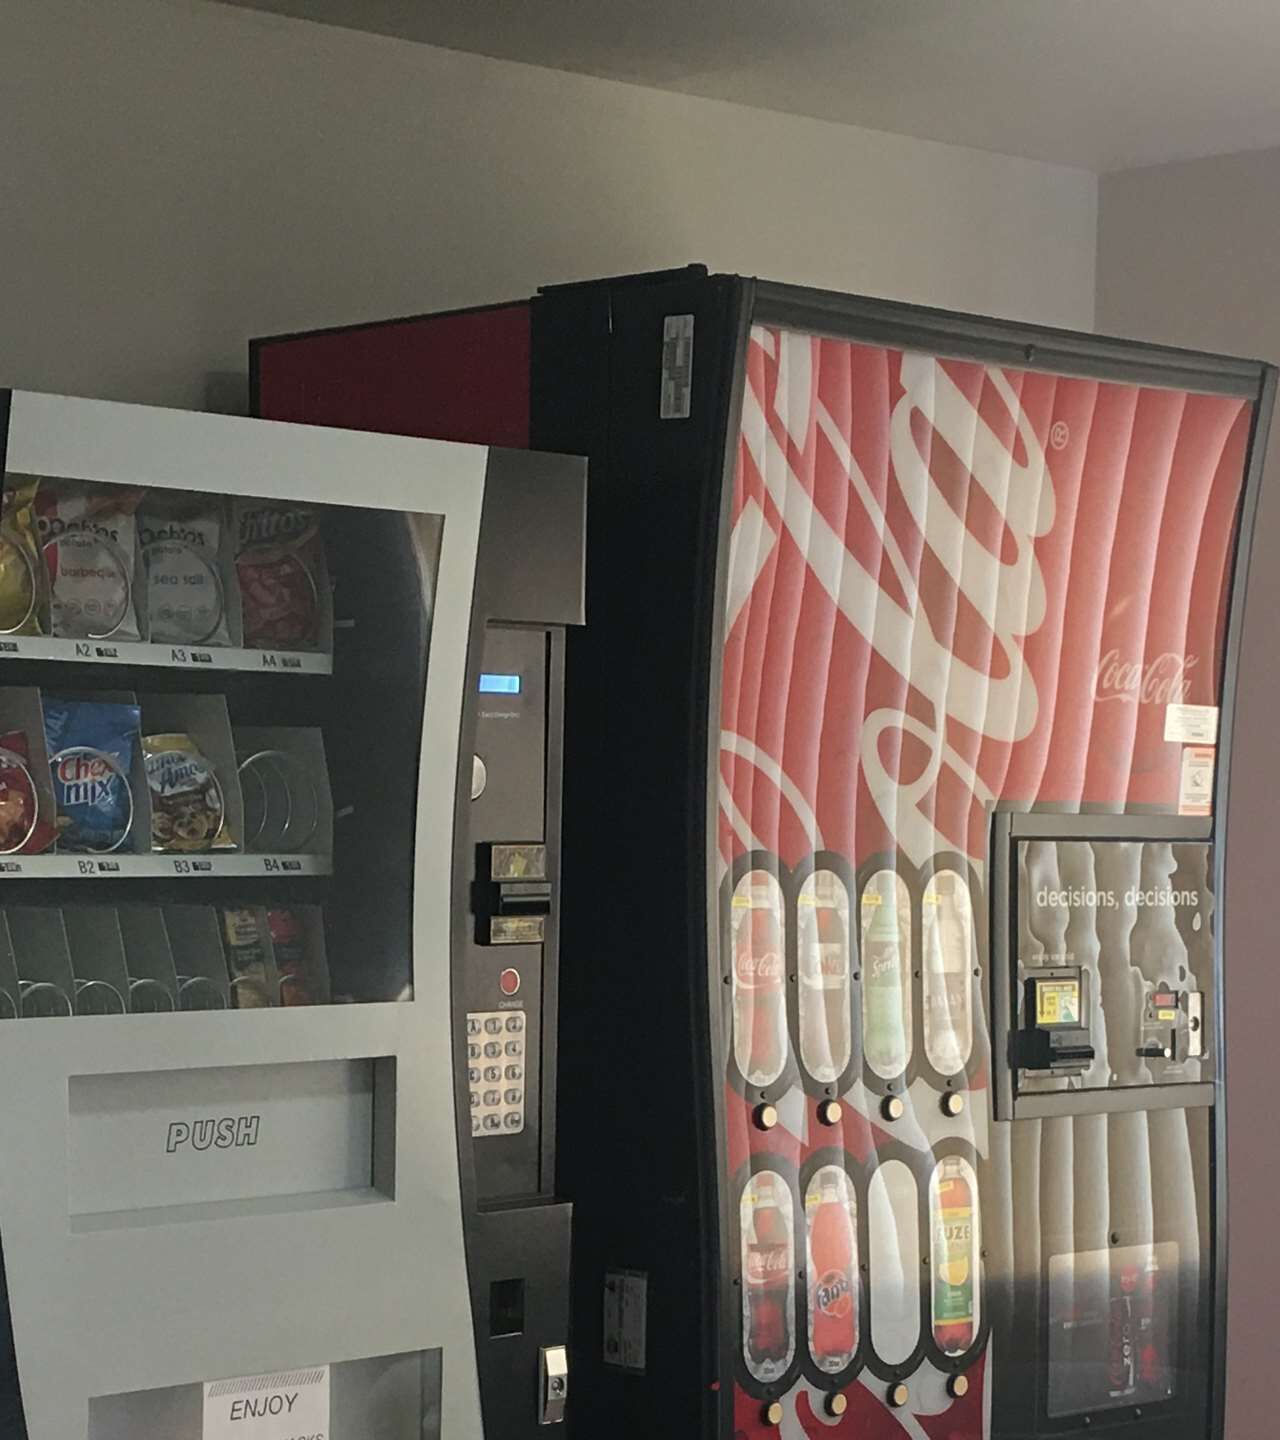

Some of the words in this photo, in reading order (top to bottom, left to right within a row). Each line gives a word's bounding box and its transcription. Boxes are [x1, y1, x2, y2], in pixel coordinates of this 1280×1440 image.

[76, 643, 91, 657] A2
[171, 649, 187, 662] A3
[262, 654, 277, 667] A4
[65, 776, 114, 806] mix
[78, 860, 94, 873] B2
[174, 860, 190, 873] B3
[264, 858, 280, 872] B4
[1036, 886, 1119, 910] decisions,
[1124, 886, 1199, 907] decisions
[166, 1115, 260, 1153] PUSH
[230, 1393, 298, 1421] ENJOY
